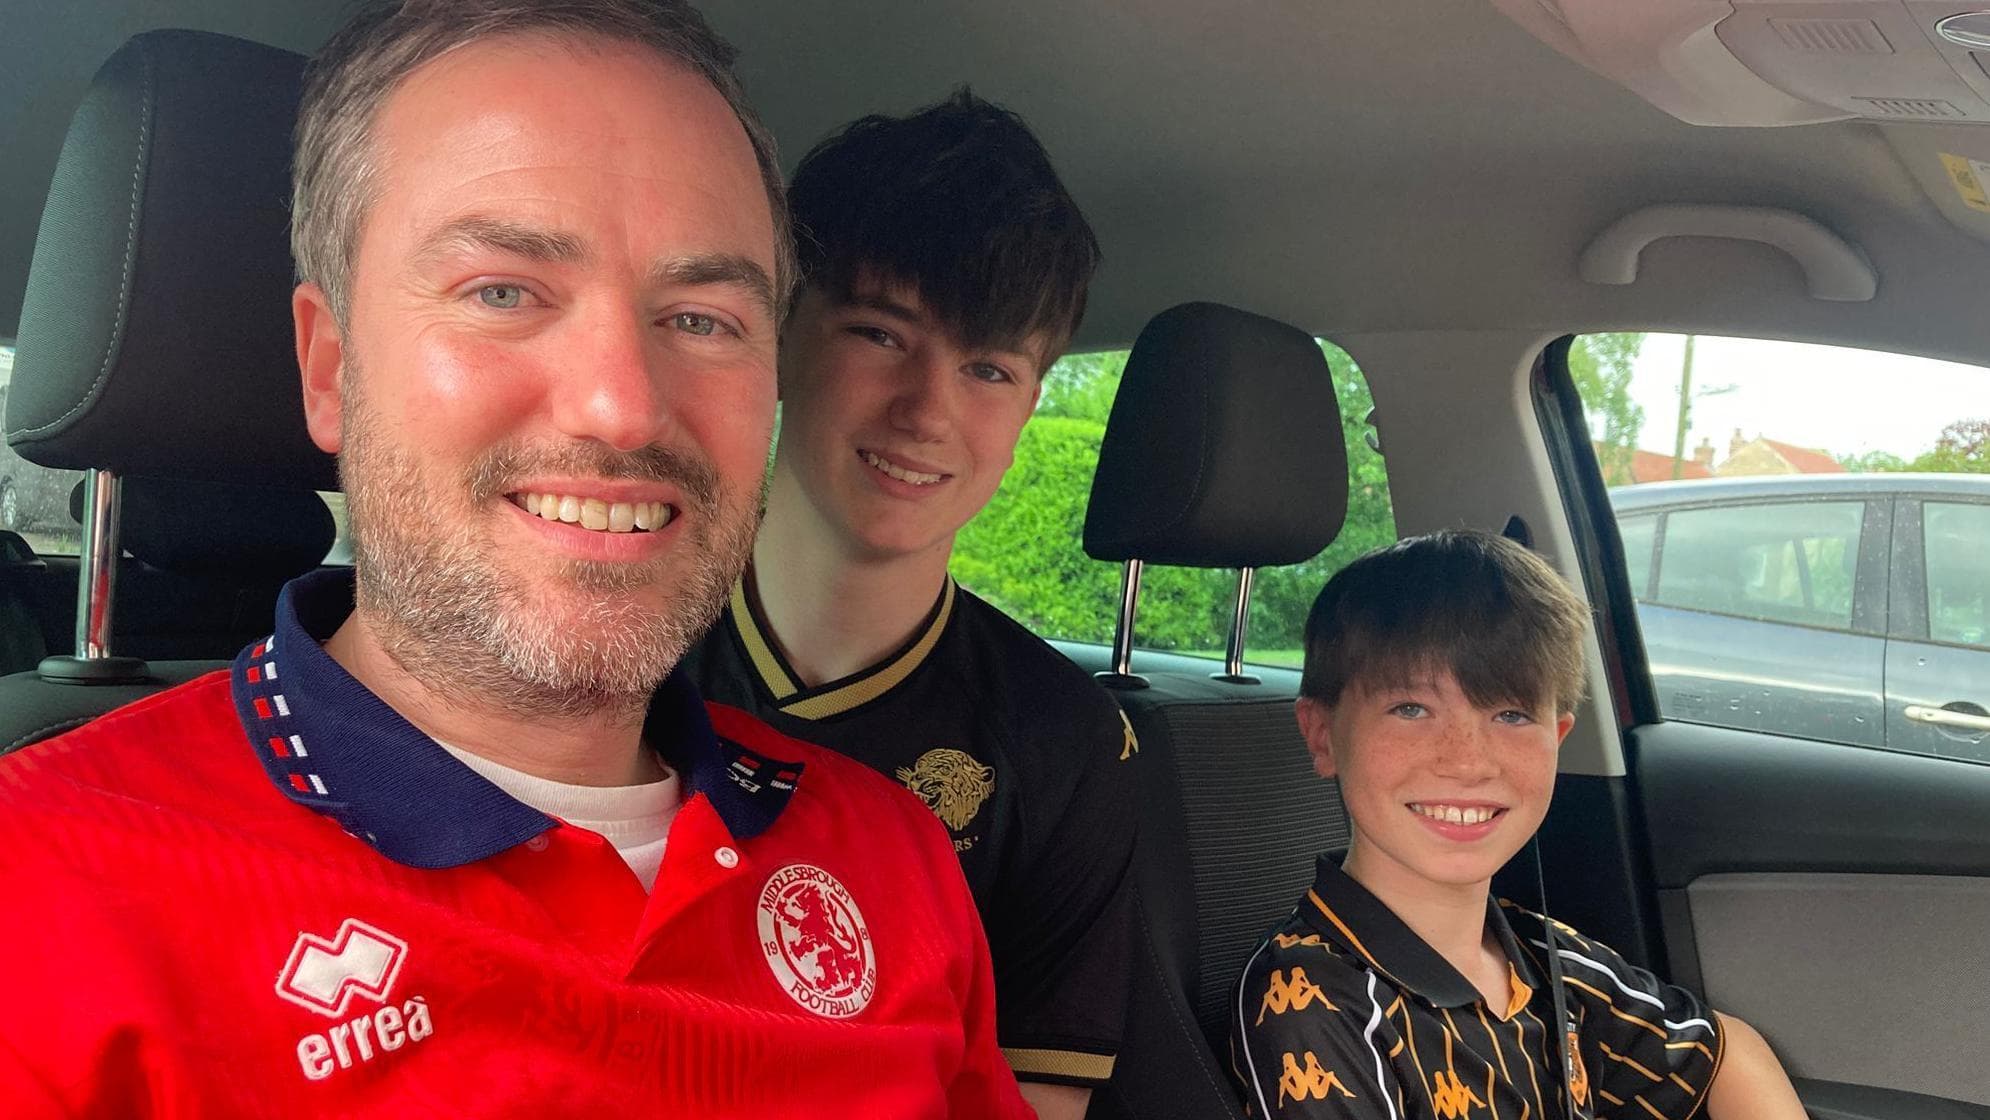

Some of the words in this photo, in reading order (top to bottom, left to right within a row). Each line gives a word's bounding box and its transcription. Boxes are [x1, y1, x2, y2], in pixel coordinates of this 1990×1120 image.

[761, 866, 850, 914] MIDDLESBROUGH
[764, 941, 778, 956] 19
[790, 980, 860, 1016] FOOTBALL
